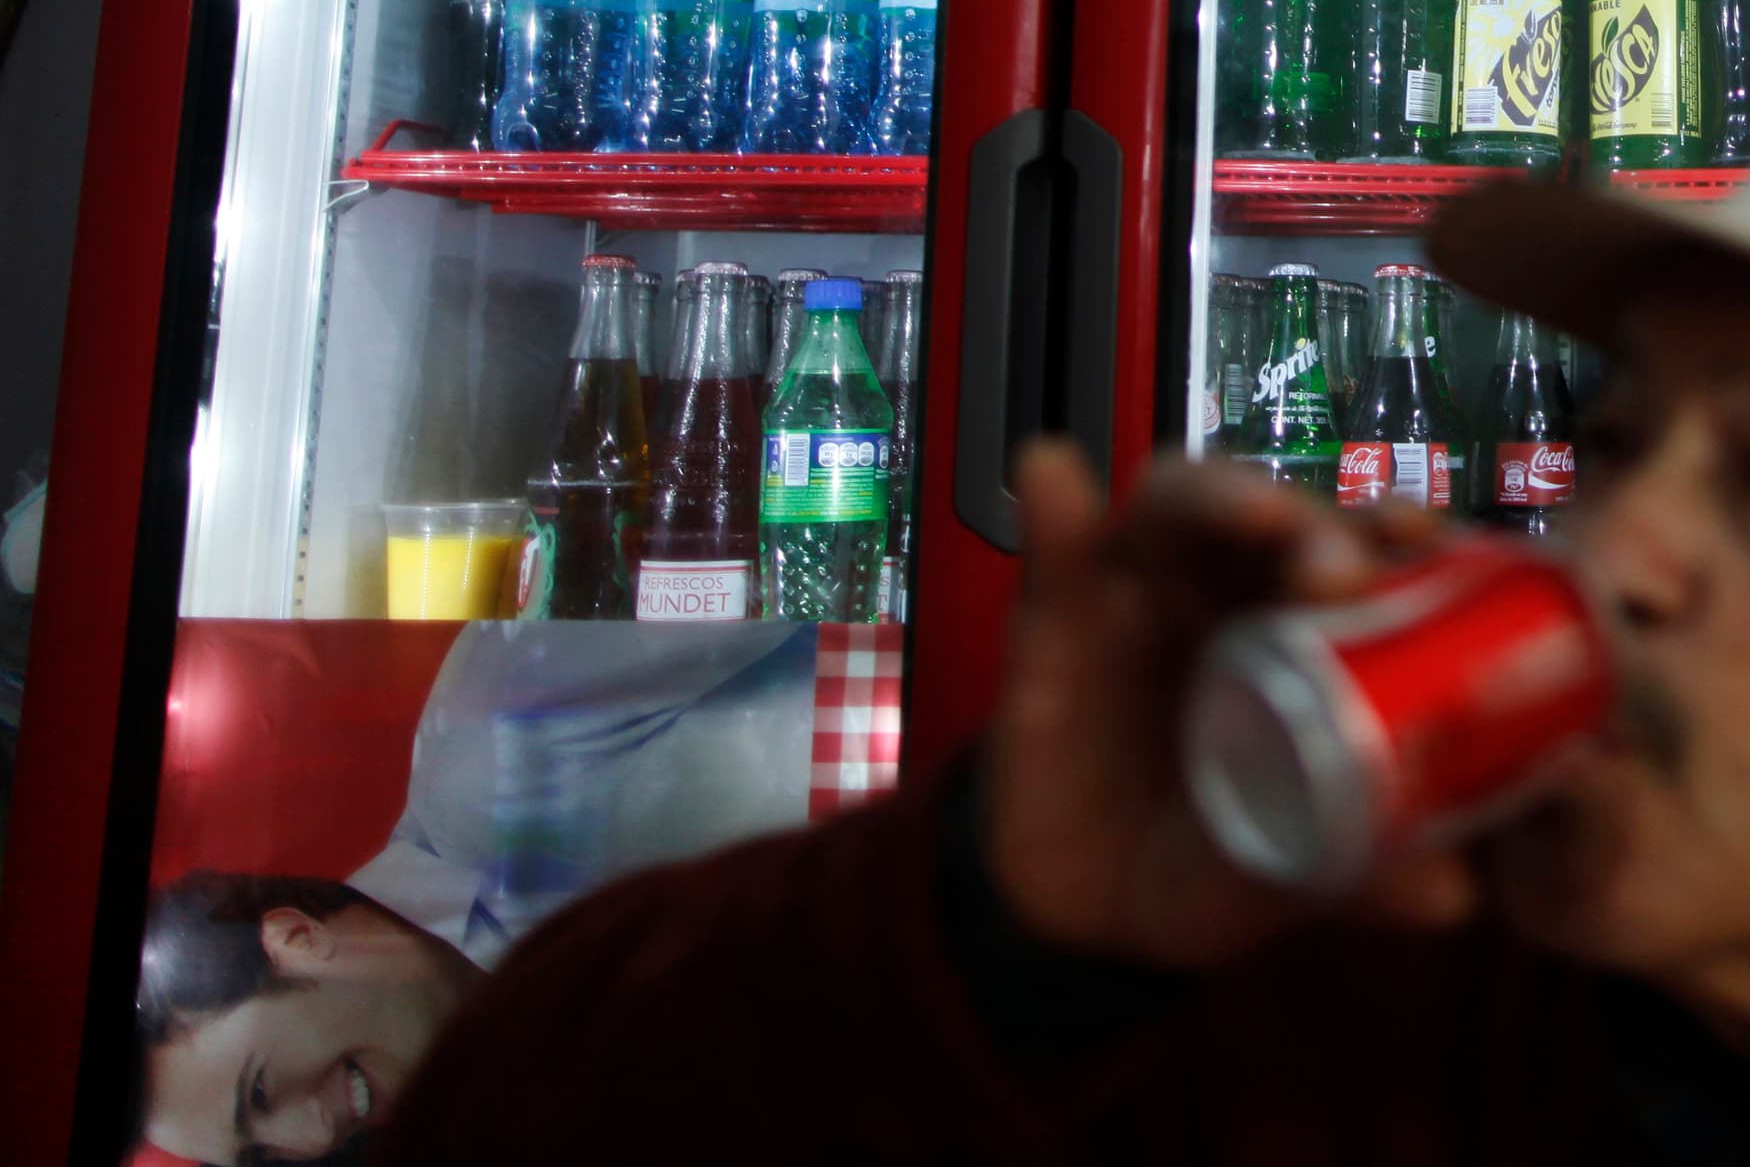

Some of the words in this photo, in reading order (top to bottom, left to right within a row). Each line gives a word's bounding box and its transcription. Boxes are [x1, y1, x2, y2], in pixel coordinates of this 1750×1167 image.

[1252, 338, 1320, 403] Sprite
[1271, 415, 1297, 424] CNT.
[644, 576, 724, 591] REFRESCOS
[639, 592, 731, 614] MUNDET
